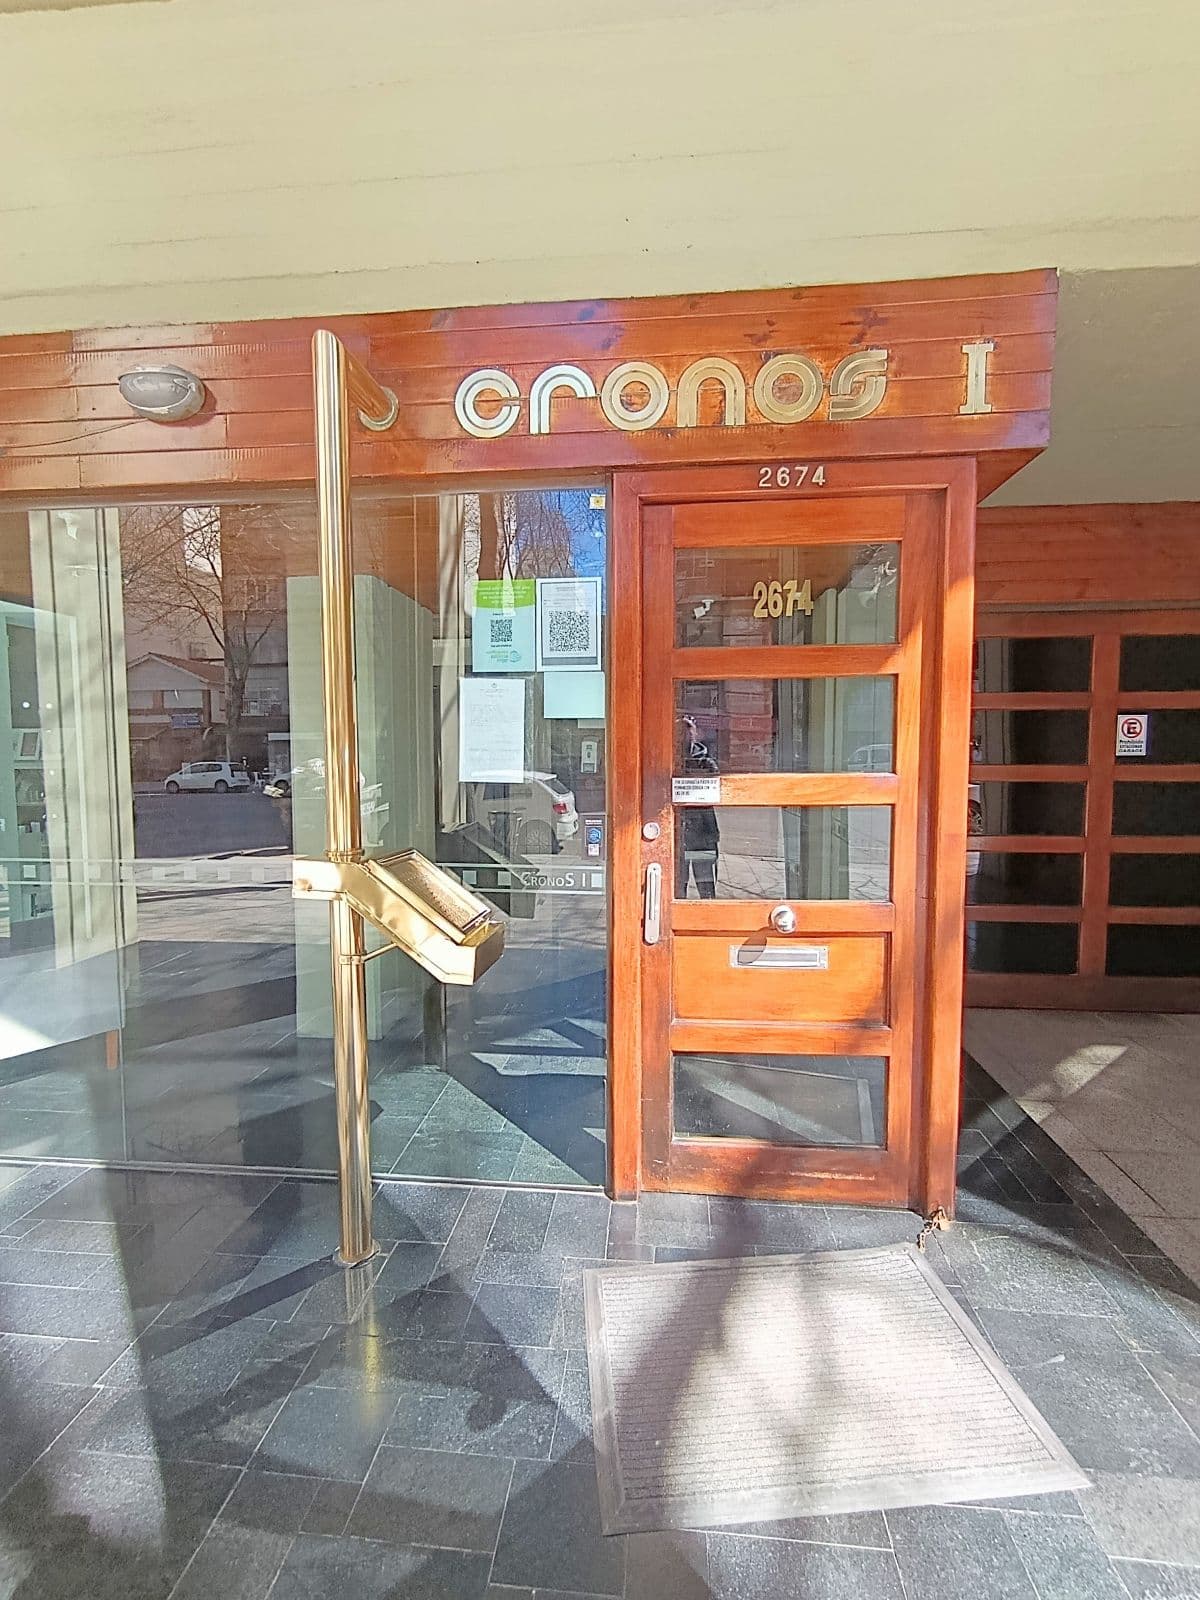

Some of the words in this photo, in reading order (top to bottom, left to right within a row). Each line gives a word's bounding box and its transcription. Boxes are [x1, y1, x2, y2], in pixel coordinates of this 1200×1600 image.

[959, 343, 995, 414] I
[758, 465, 826, 487] 2674
[753, 579, 814, 618] 2674
